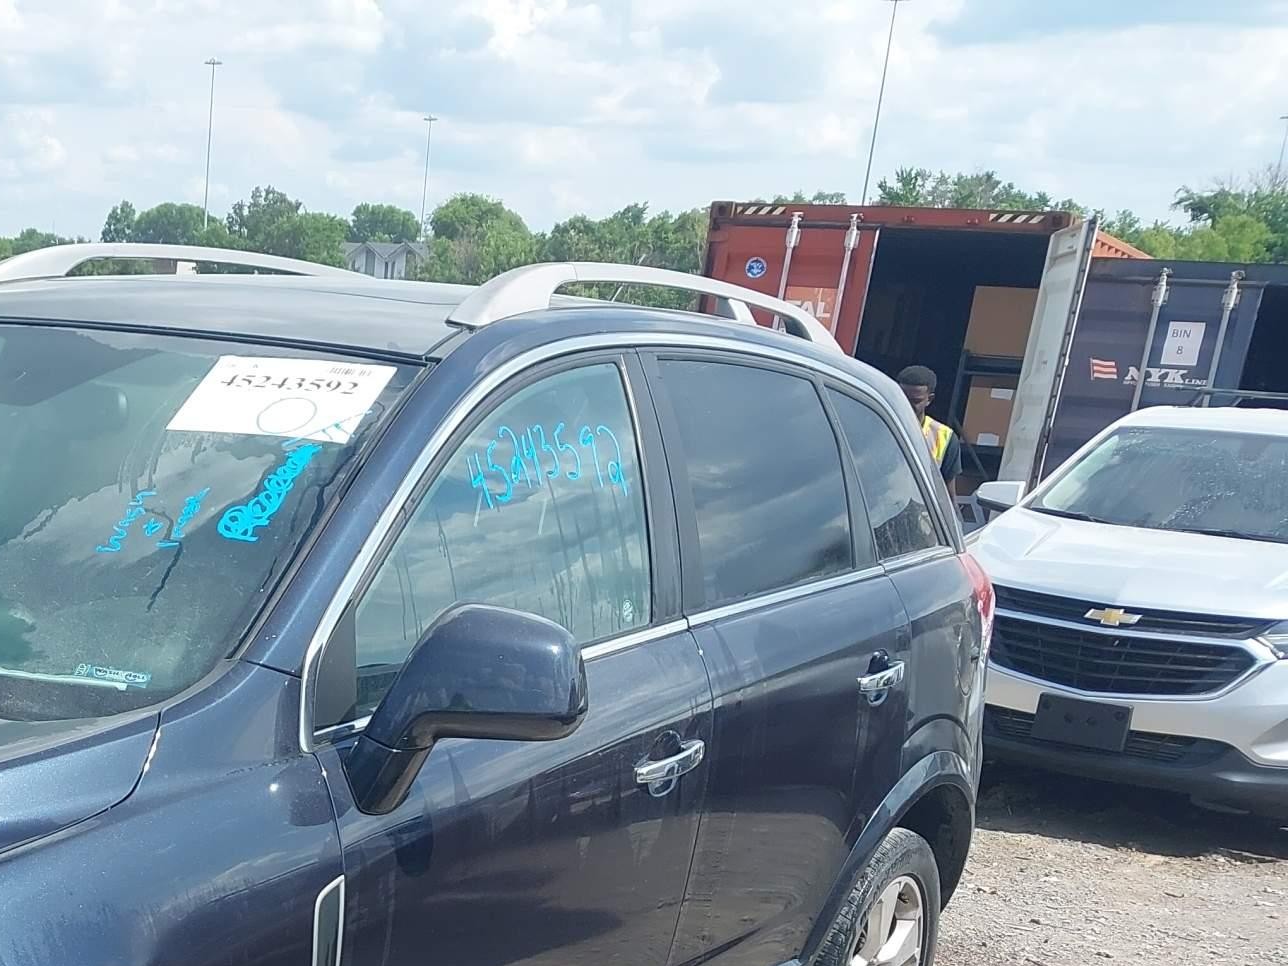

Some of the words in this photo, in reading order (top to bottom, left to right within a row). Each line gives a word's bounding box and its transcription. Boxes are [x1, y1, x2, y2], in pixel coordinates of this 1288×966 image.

[1172, 328, 1192, 338] BIN
[1176, 345, 1184, 355] 8
[1124, 366, 1189, 383] NYK
[220, 373, 359, 395] 45243592
[466, 422, 628, 509] 45243592
